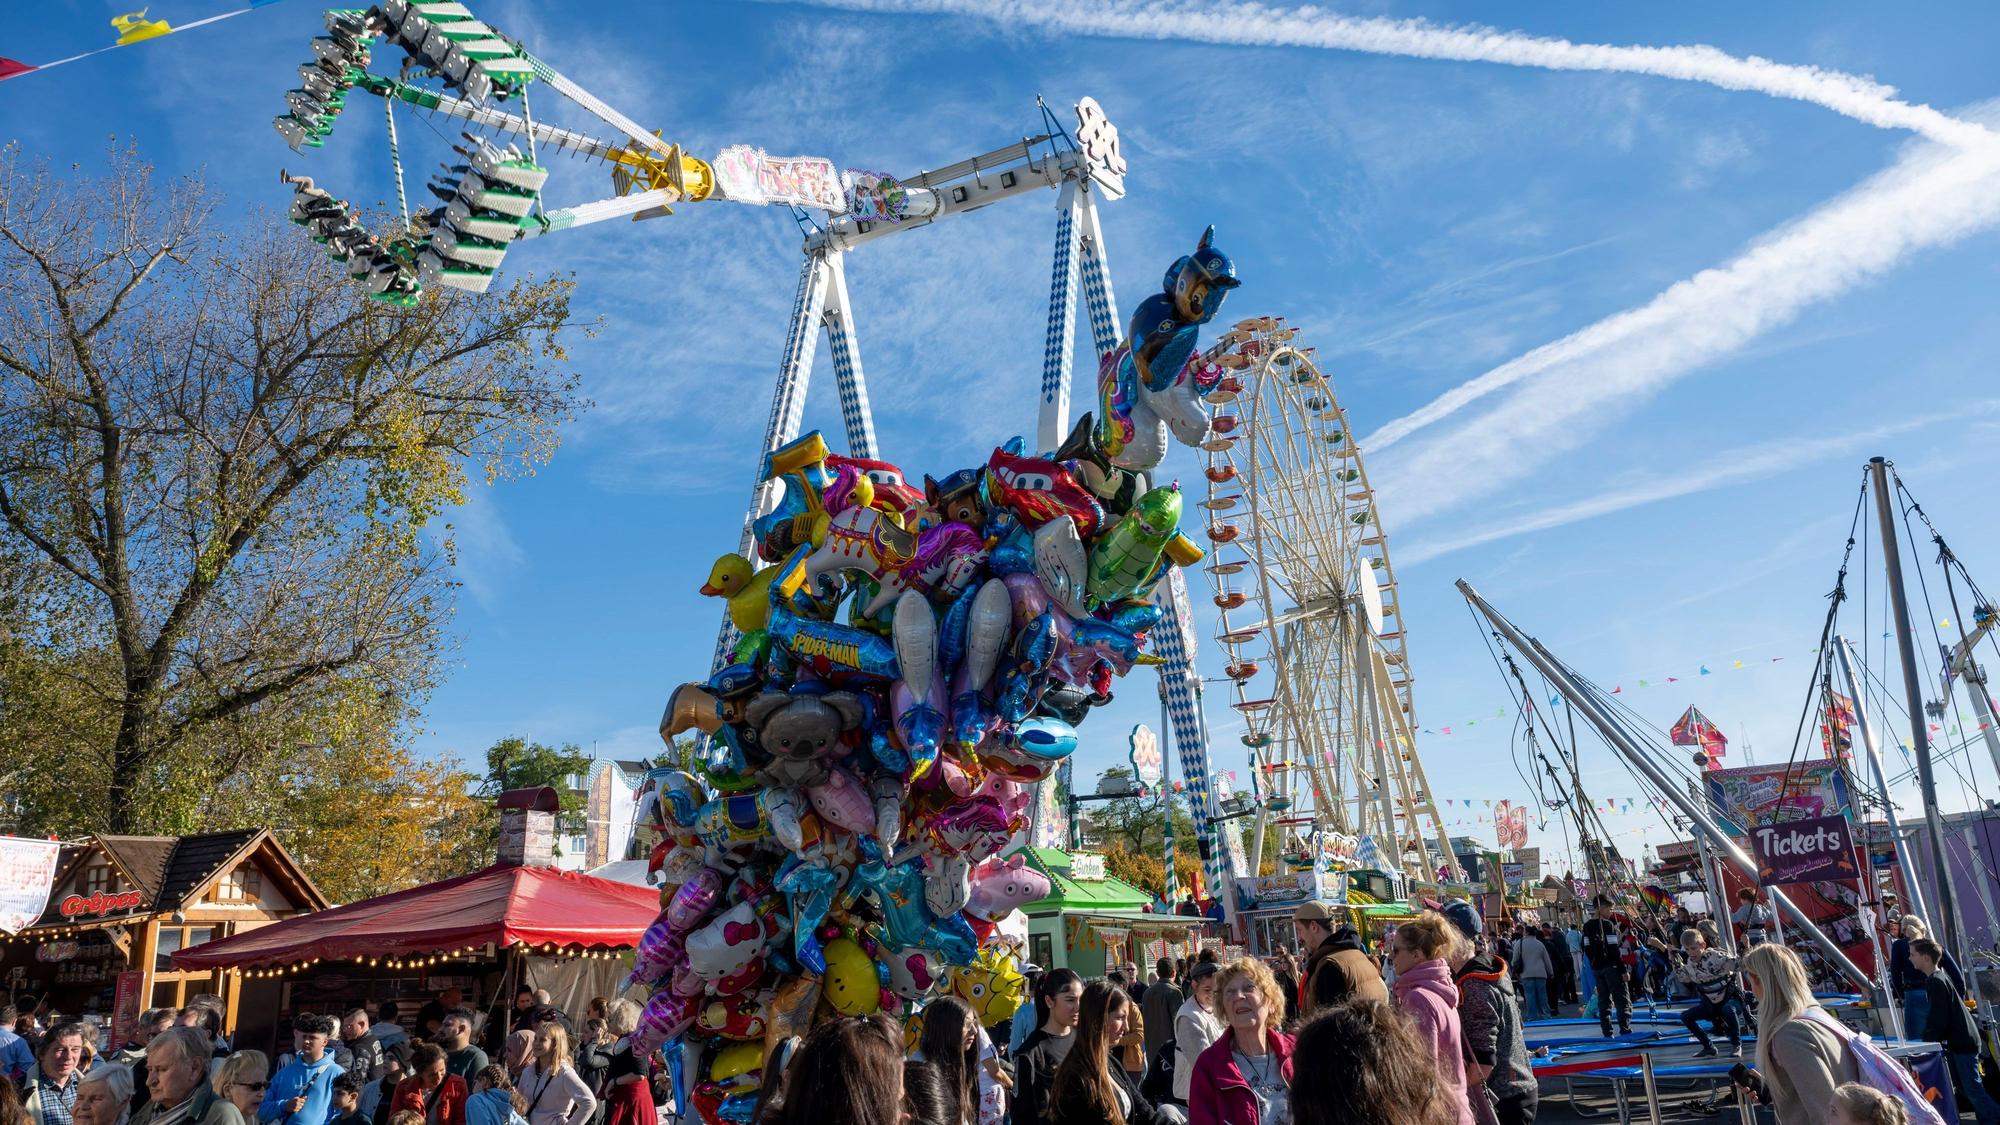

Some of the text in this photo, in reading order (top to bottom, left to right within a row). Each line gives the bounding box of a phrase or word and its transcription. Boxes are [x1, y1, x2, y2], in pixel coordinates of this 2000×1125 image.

[791, 631, 861, 670] SPIDER-MAN
[1734, 777, 1779, 803] Beverly
[1756, 826, 1841, 857] Tickets
[1076, 858, 1100, 876] Gurken
[1257, 877, 1297, 891] KASSE
[61, 891, 142, 917] Crêpes
